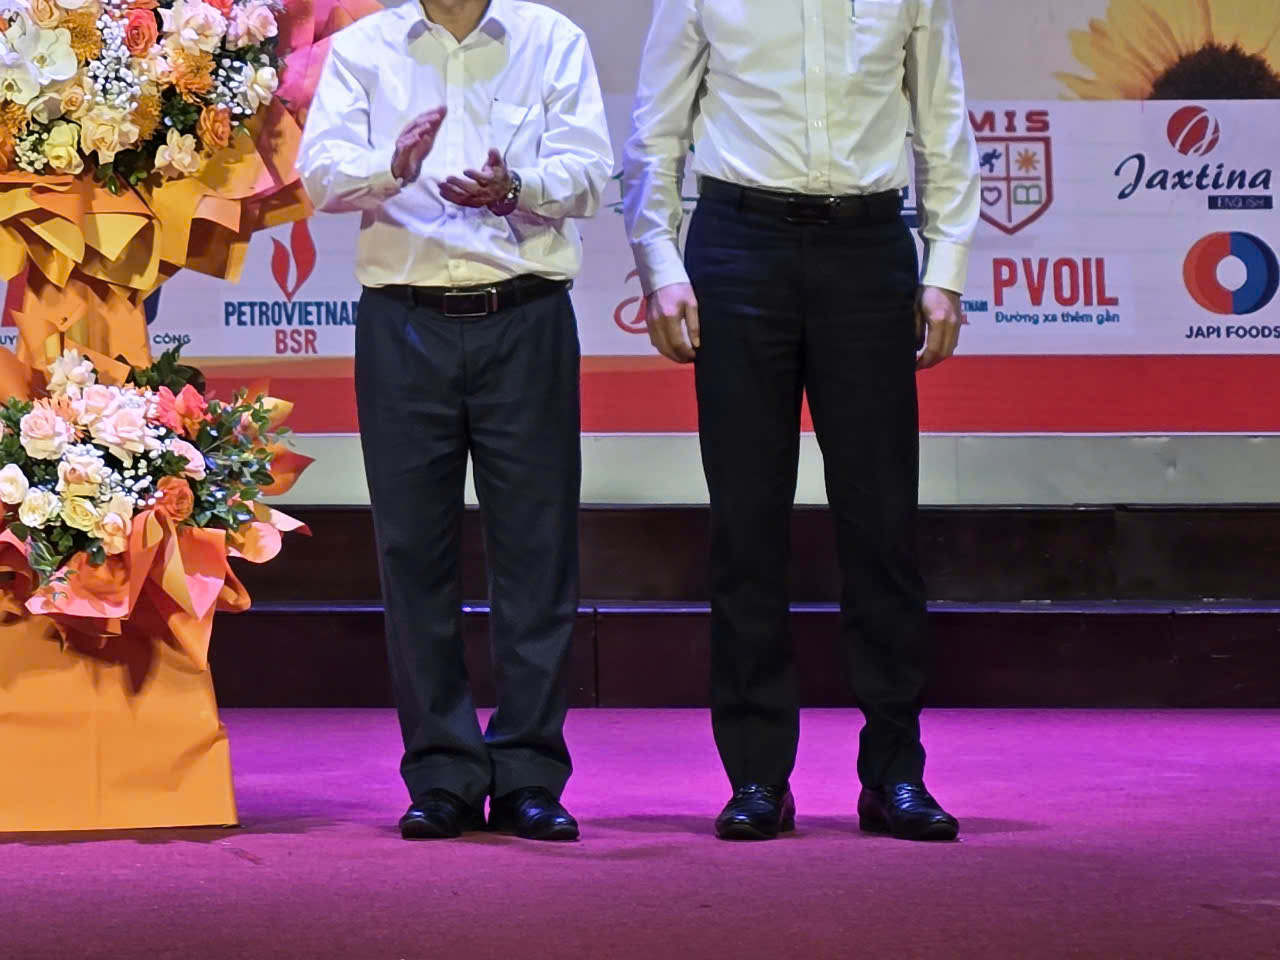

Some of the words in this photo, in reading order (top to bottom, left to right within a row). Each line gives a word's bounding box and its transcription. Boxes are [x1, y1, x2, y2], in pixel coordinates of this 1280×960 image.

[1114, 152, 1272, 200] Jaxtina
[992, 257, 1120, 307] PVOIL
[994, 310, 1040, 326] Đường
[1061, 311, 1093, 324] thêm
[153, 333, 192, 345] CÔNG
[275, 328, 318, 355] BSR
[1185, 325, 1222, 339] JAPI
[1225, 325, 1280, 340] FOODS
